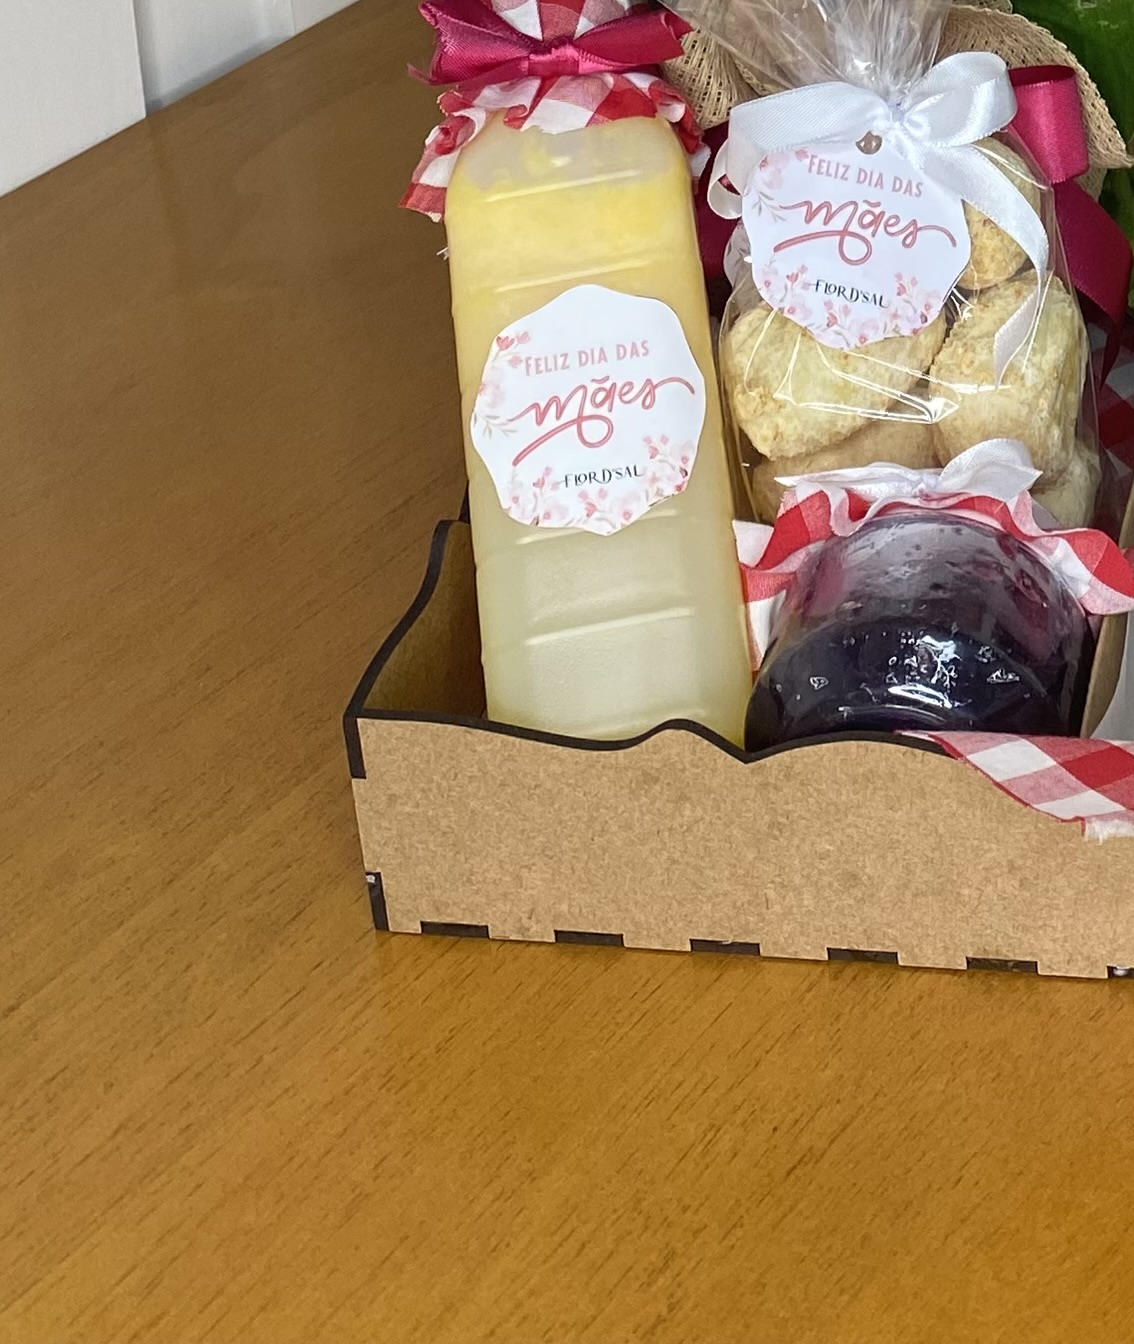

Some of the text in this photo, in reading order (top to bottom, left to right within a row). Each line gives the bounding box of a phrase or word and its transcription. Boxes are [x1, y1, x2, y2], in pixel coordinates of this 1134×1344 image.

[807, 154, 924, 198] FELIZ DIA DAS
[524, 339, 650, 377] FELIZ DIA DAS
